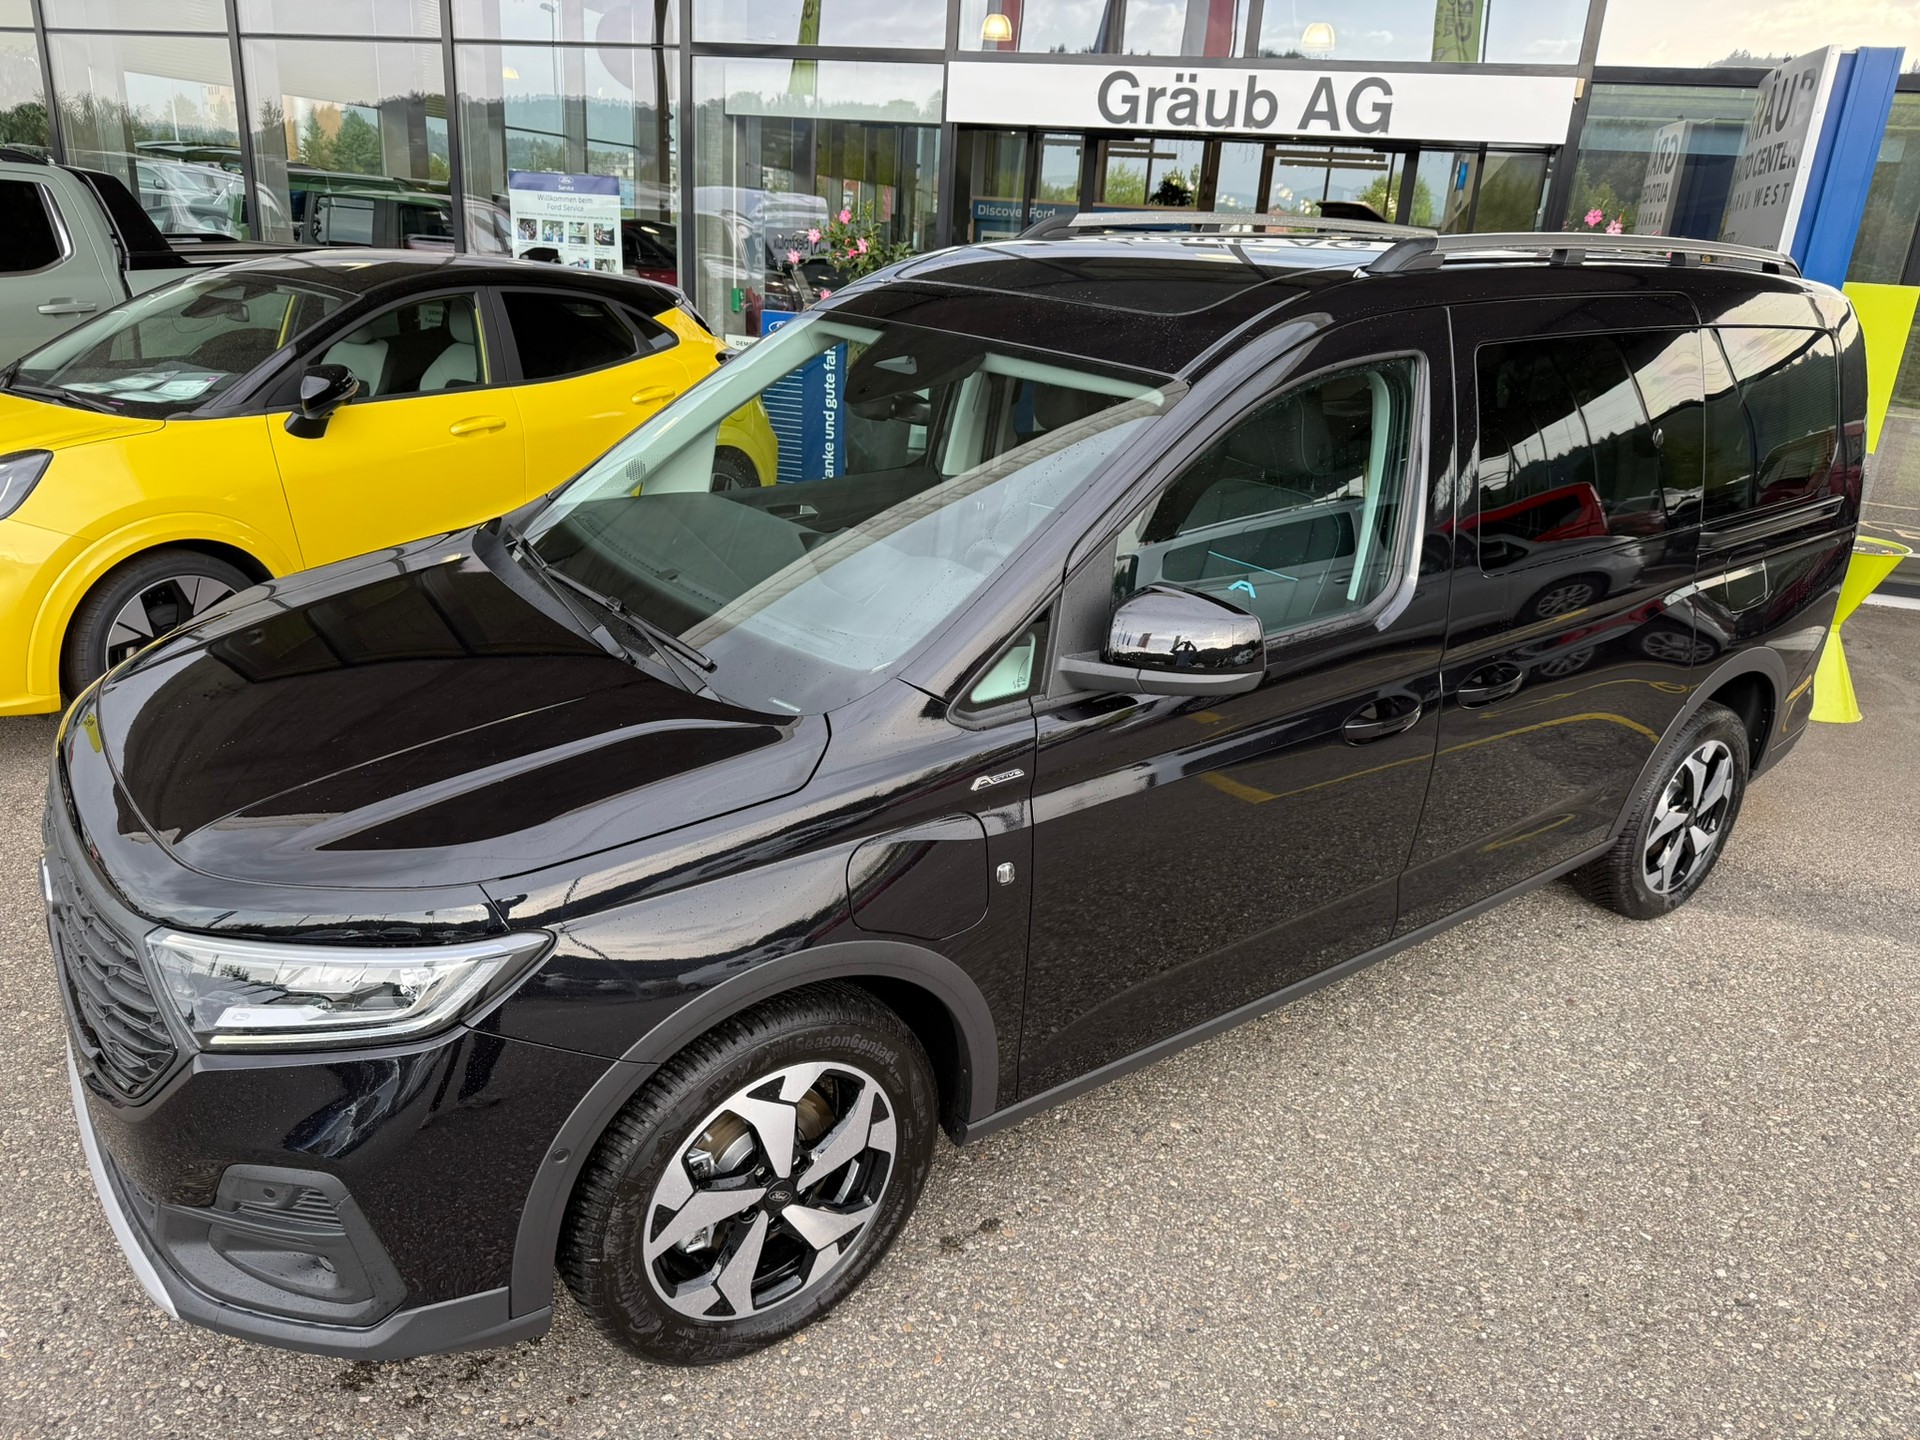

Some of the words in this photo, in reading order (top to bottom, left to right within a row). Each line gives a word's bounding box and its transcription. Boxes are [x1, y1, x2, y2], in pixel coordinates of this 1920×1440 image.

[1097, 70, 1279, 130] Gräub
[1297, 76, 1393, 134] AG
[537, 194, 577, 204] Willkommen
[577, 196, 593, 204] beim
[546, 203, 562, 211] Ford
[563, 204, 585, 212] Service
[977, 204, 1022, 217] Discove
[1028, 207, 1056, 219] Ford
[824, 373, 837, 408] gute
[823, 411, 835, 440] und
[822, 442, 835, 479] anke
